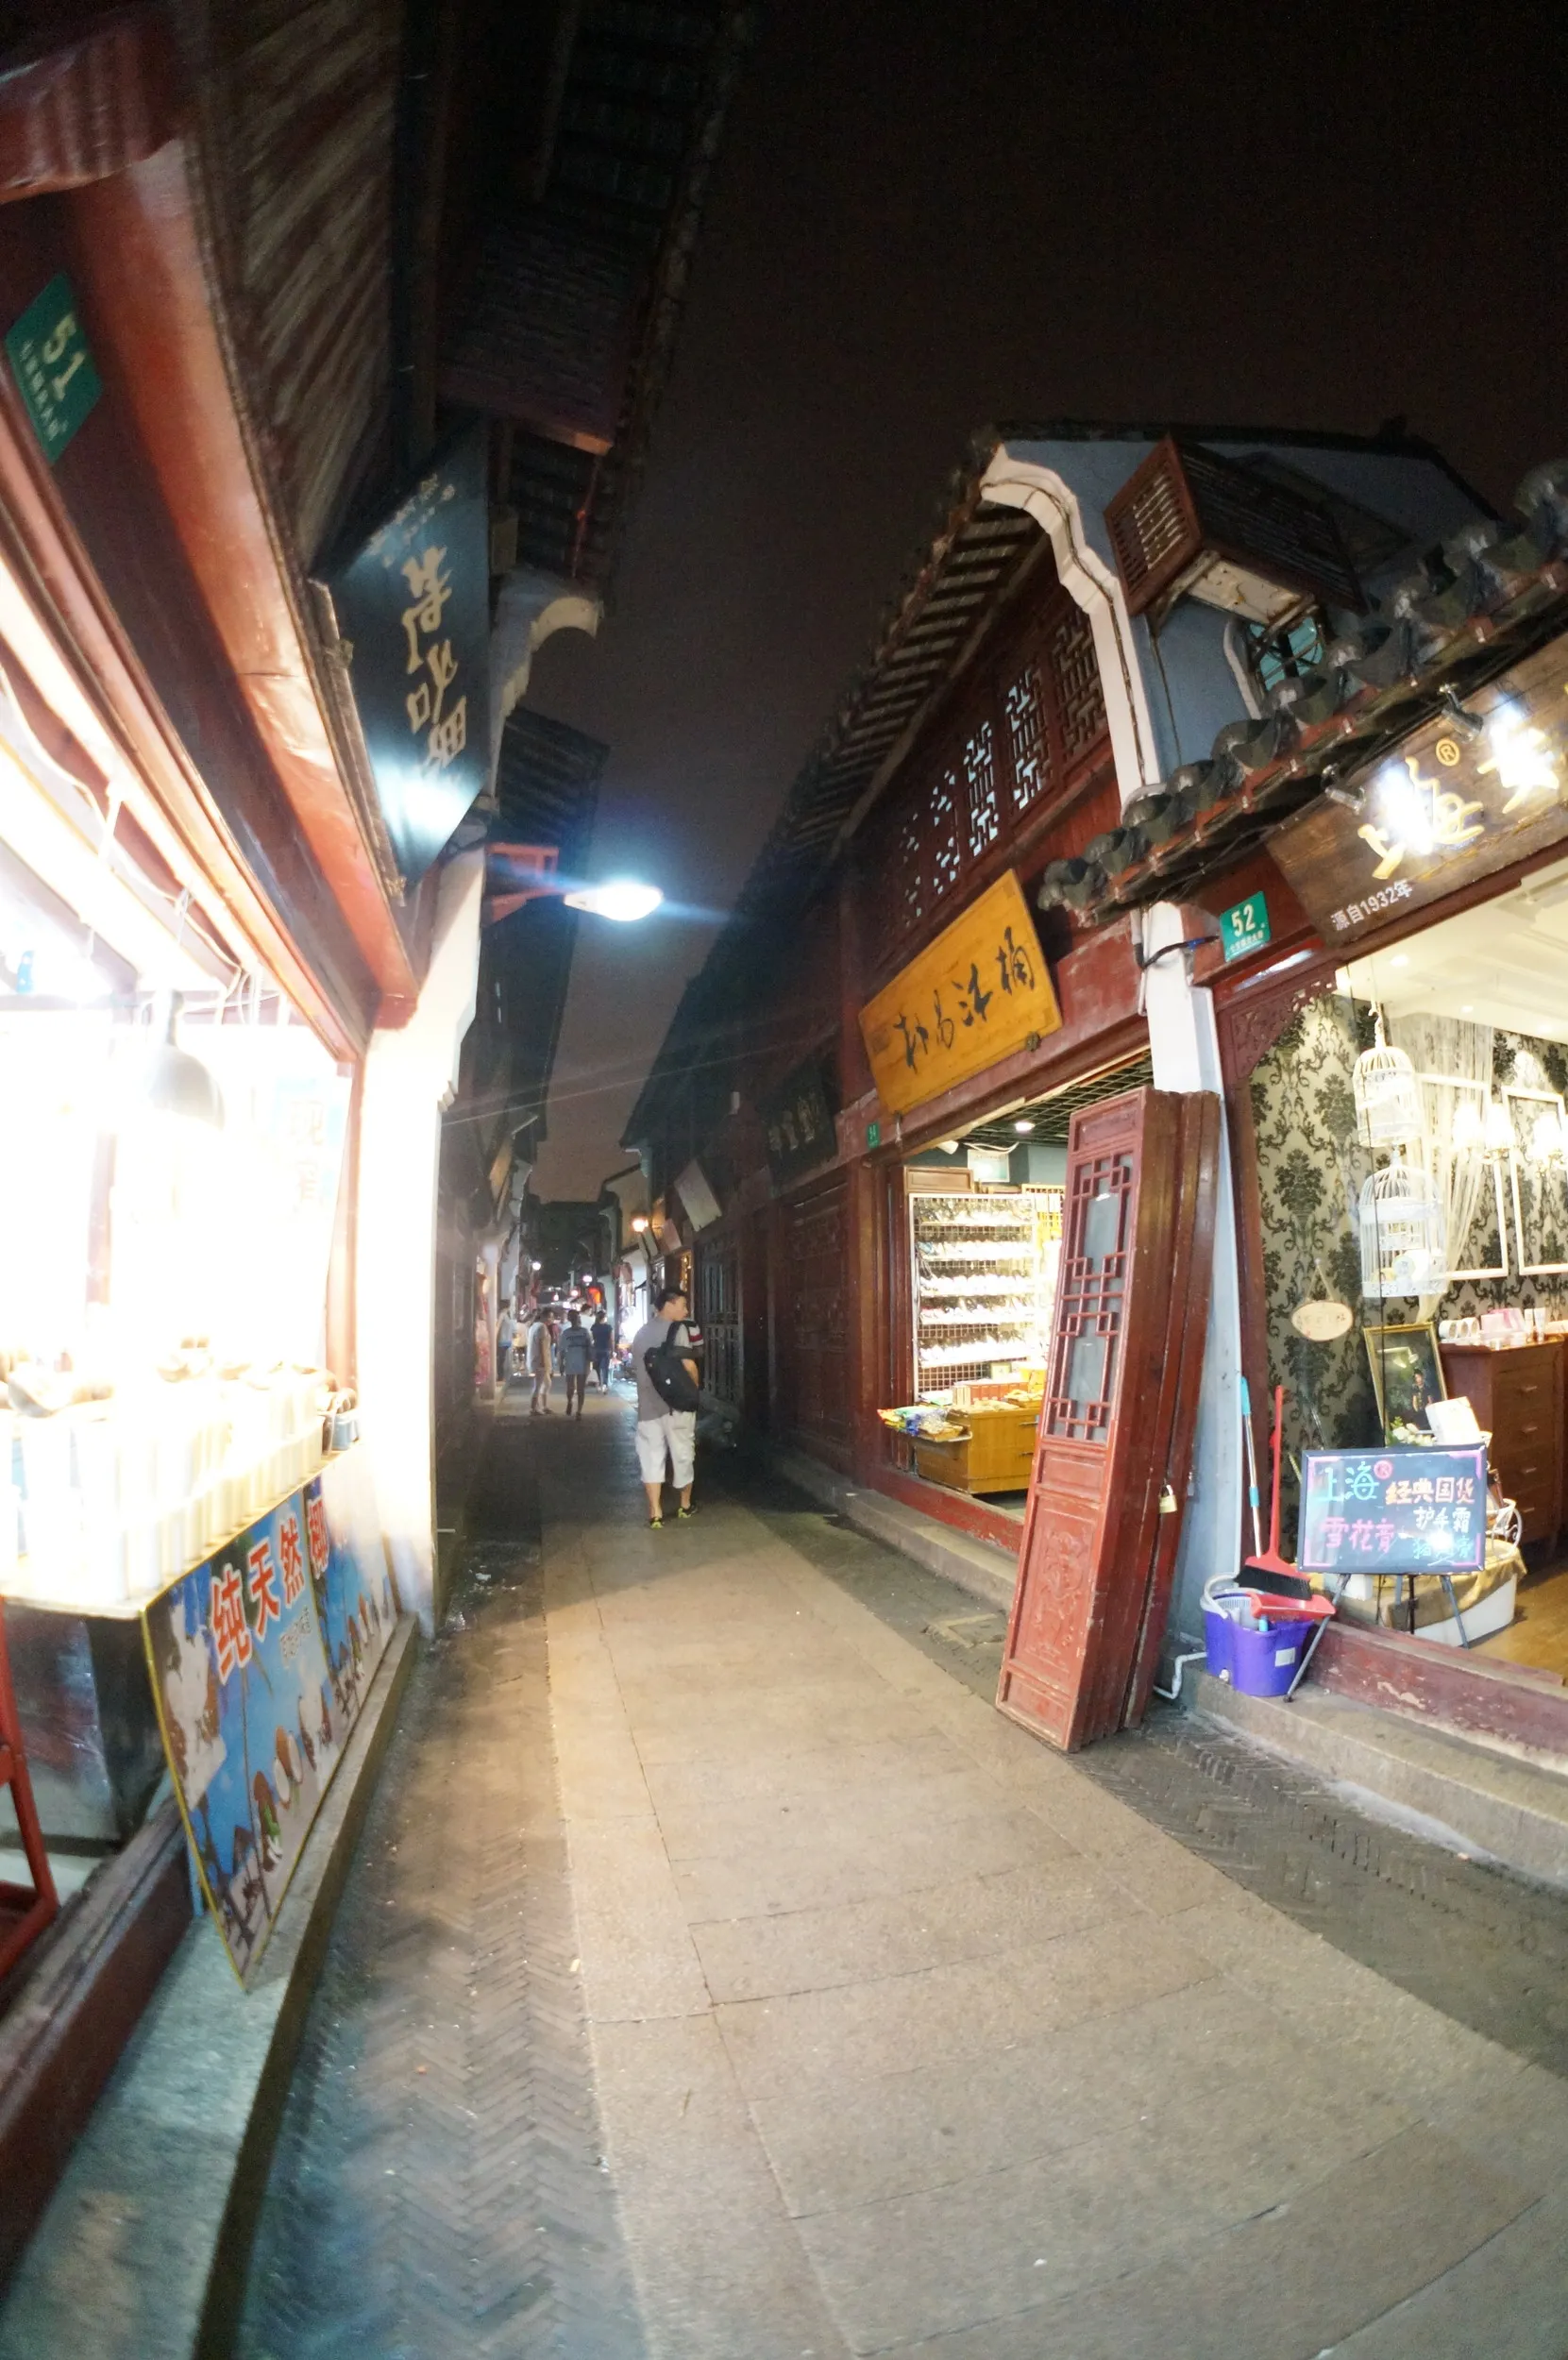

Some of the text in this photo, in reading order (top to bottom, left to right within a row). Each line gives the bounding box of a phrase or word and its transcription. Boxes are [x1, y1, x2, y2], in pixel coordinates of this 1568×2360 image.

[42, 312, 86, 402] 51
[1230, 903, 1256, 938] 52
[1330, 879, 1413, 932] 源自1932年
[1386, 1476, 1475, 1505] 经典国货
[1319, 1516, 1395, 1554] 雪花膏
[1413, 1506, 1471, 1533] 护手霜
